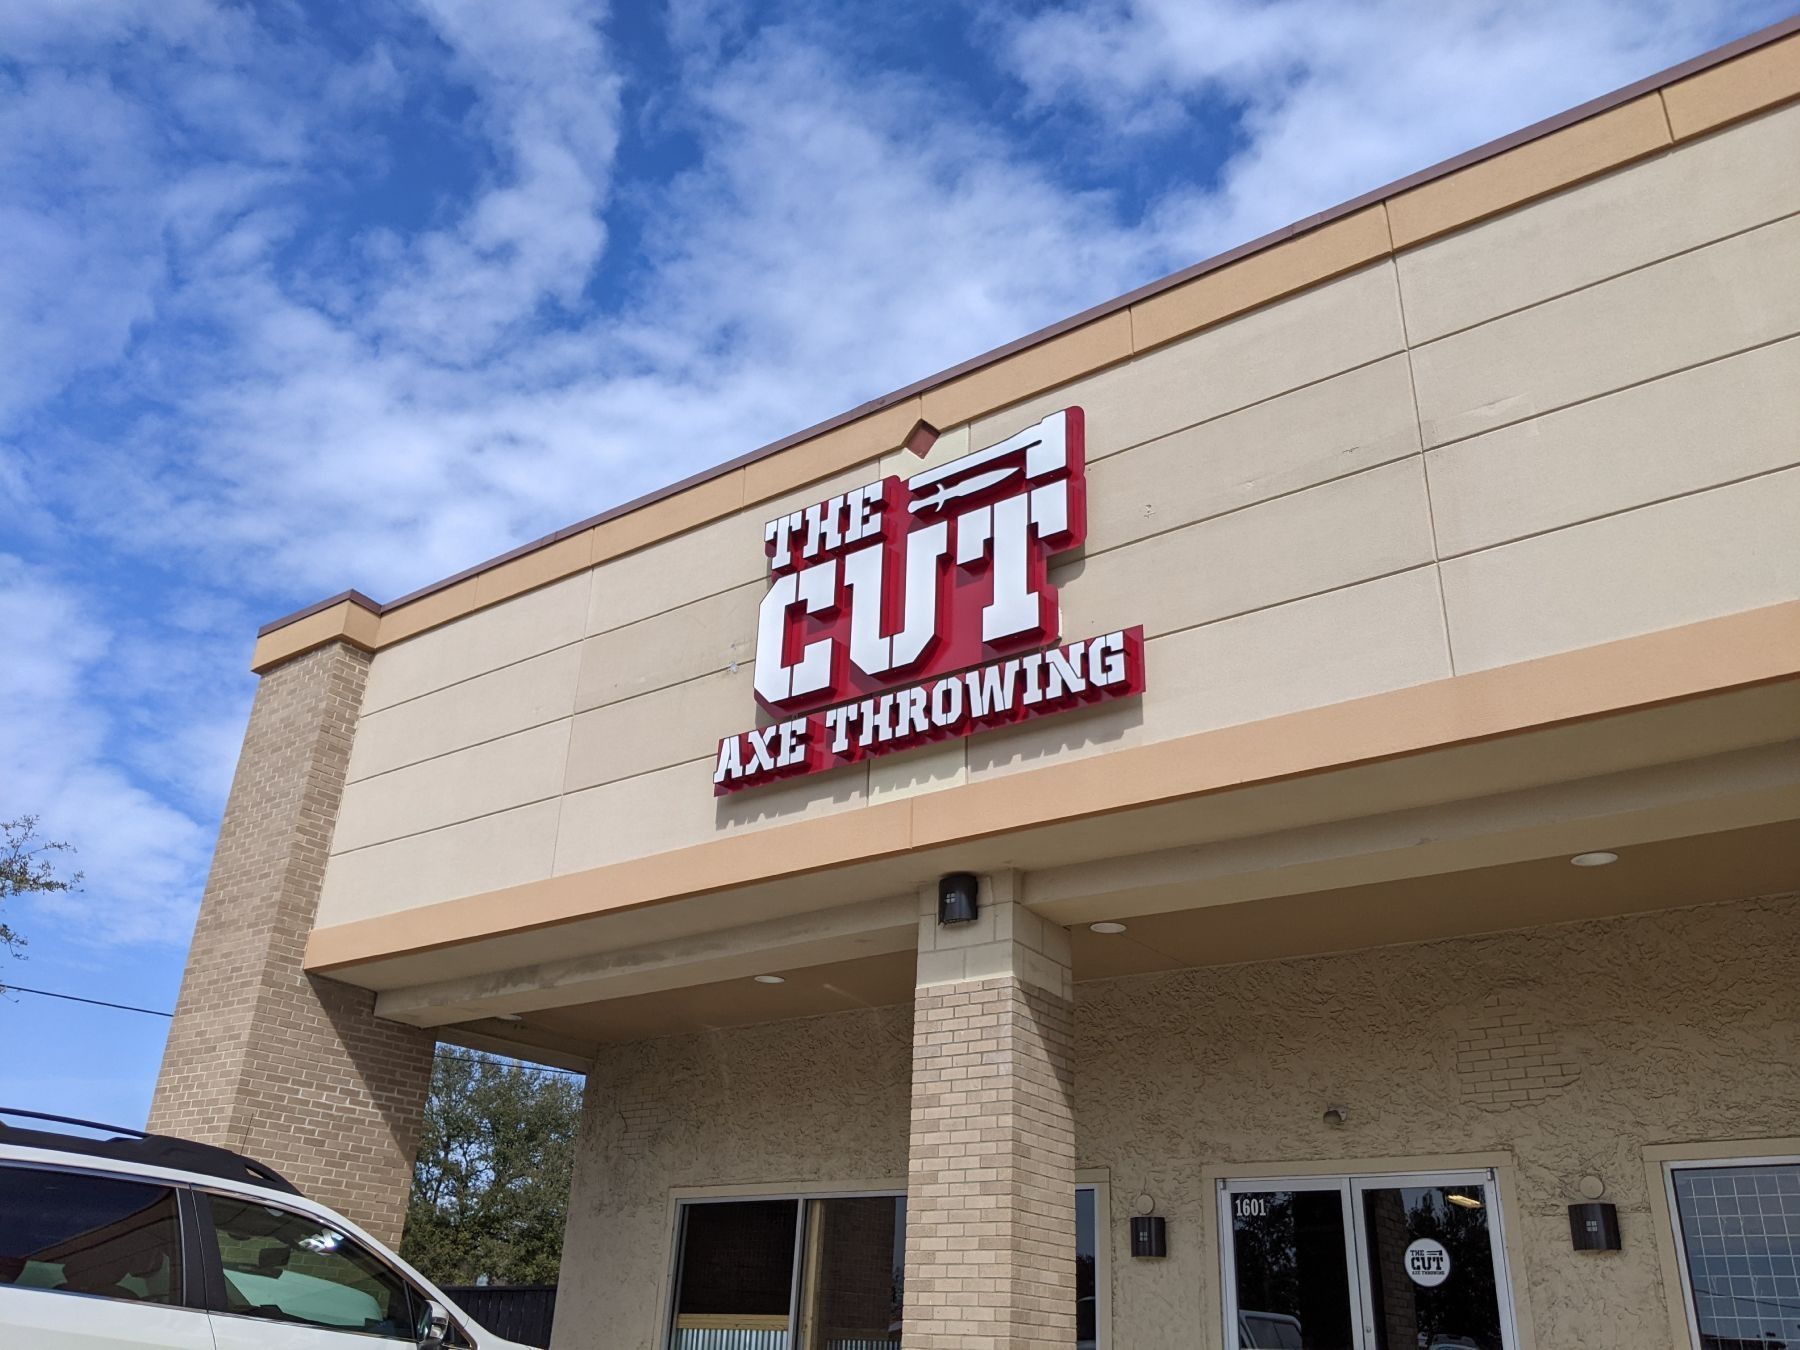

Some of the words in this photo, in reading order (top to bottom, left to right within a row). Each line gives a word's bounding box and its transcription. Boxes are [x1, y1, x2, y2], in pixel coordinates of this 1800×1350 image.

[765, 480, 885, 571] THE
[753, 478, 1069, 704] CUT
[713, 716, 809, 784] AXE
[825, 630, 1126, 755] THROWING
[1235, 1198, 1267, 1217] 1601
[1410, 1249, 1425, 1257] THE
[1410, 1256, 1444, 1271] CUT
